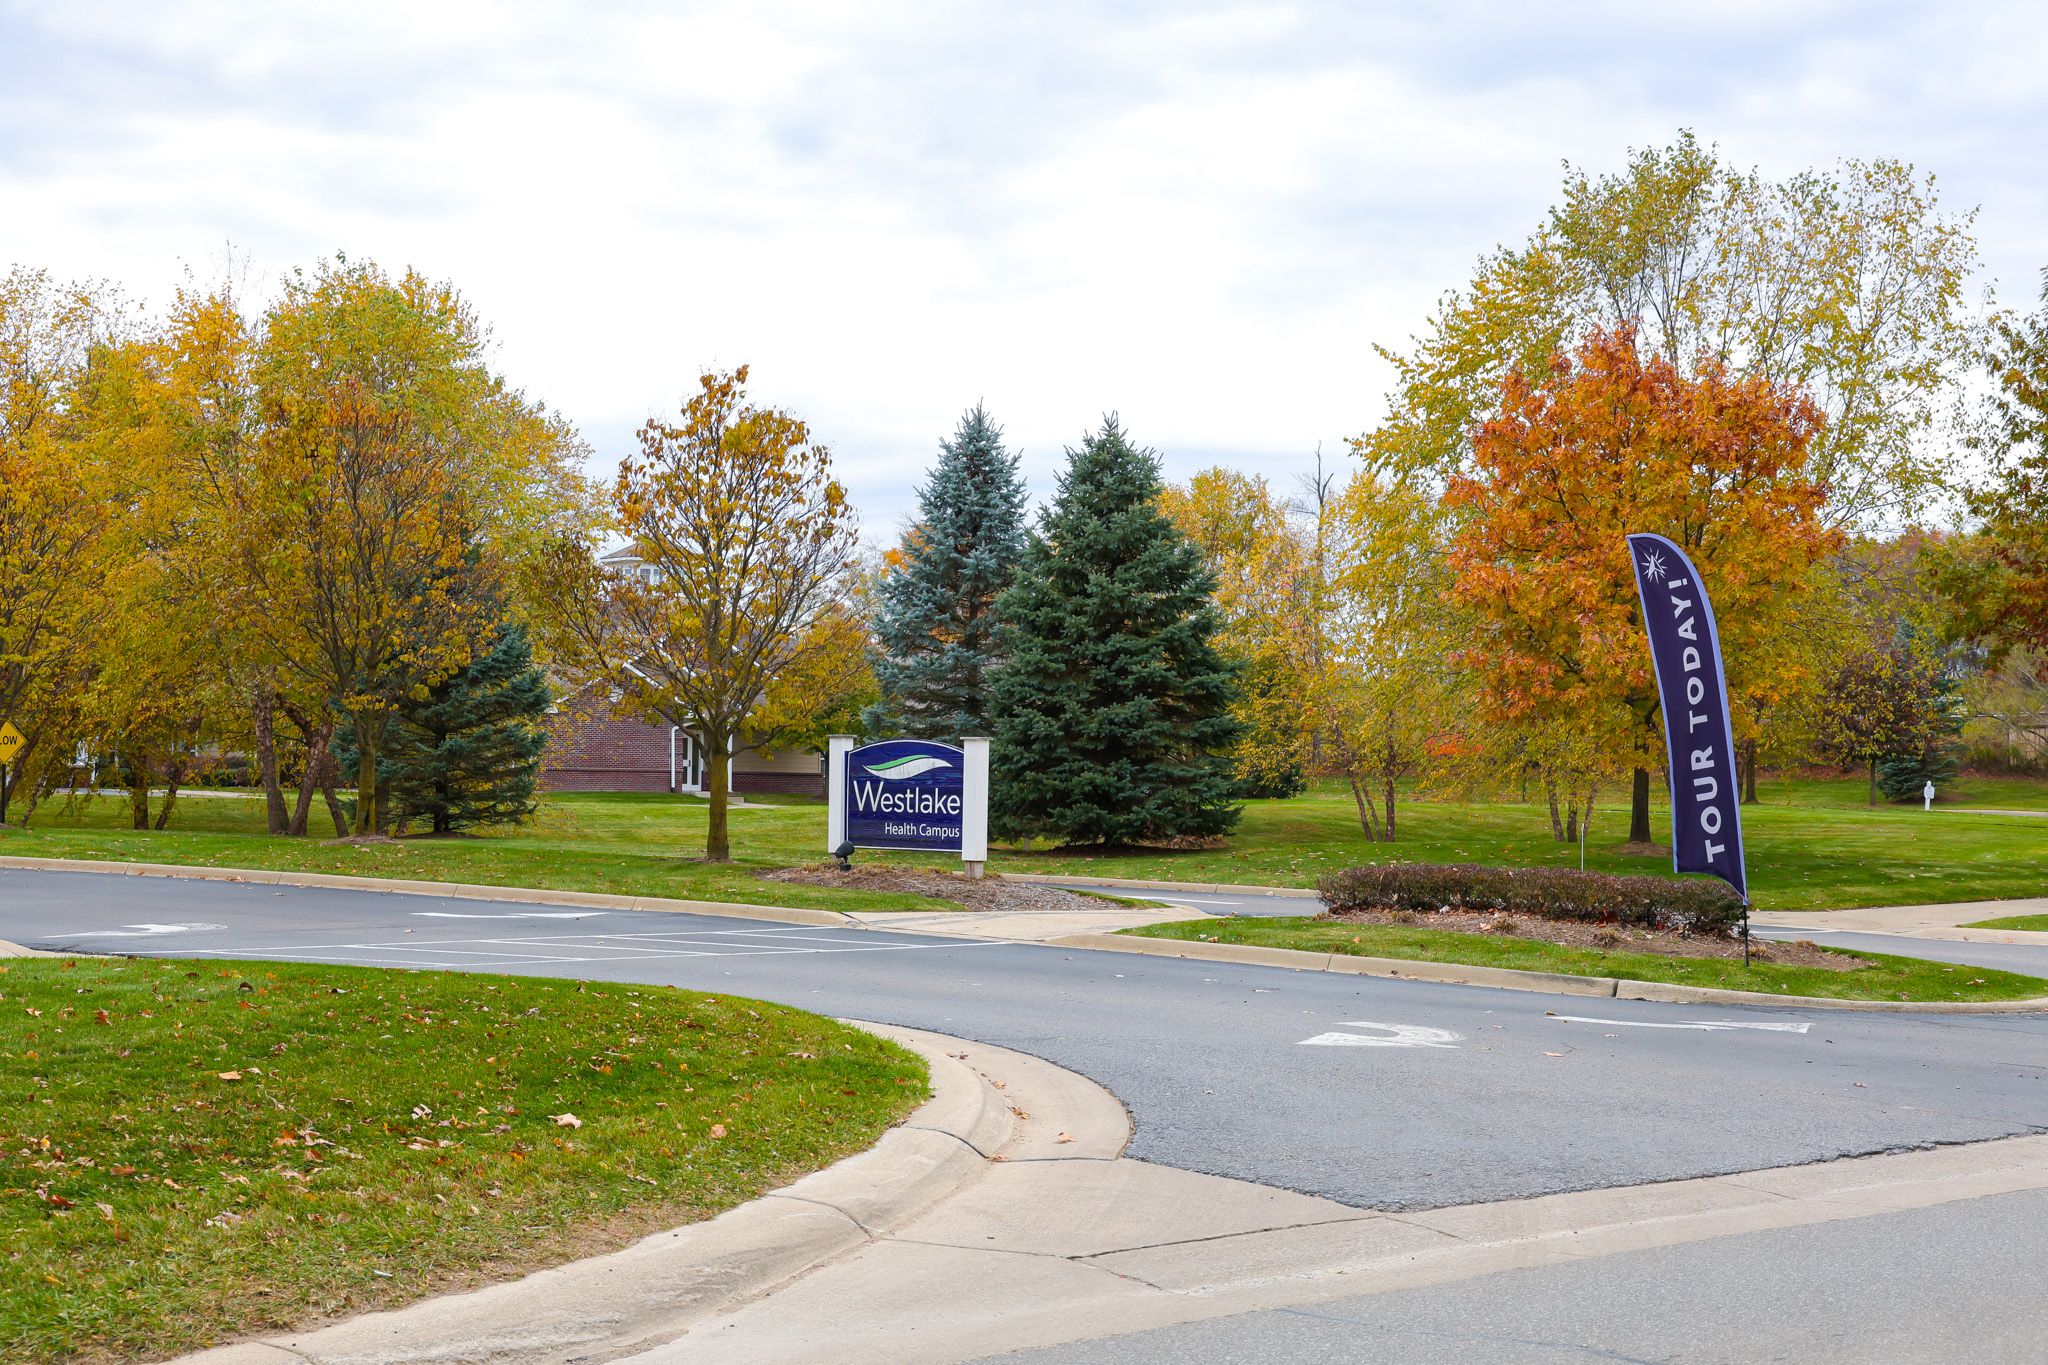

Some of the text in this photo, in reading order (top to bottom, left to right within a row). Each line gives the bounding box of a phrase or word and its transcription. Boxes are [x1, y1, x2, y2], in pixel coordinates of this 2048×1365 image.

[1667, 577, 1726, 863] TOUR TODAY!
[0, 735, 18, 745] OW
[853, 780, 961, 815] Westlake
[884, 822, 960, 839] Health Campus
